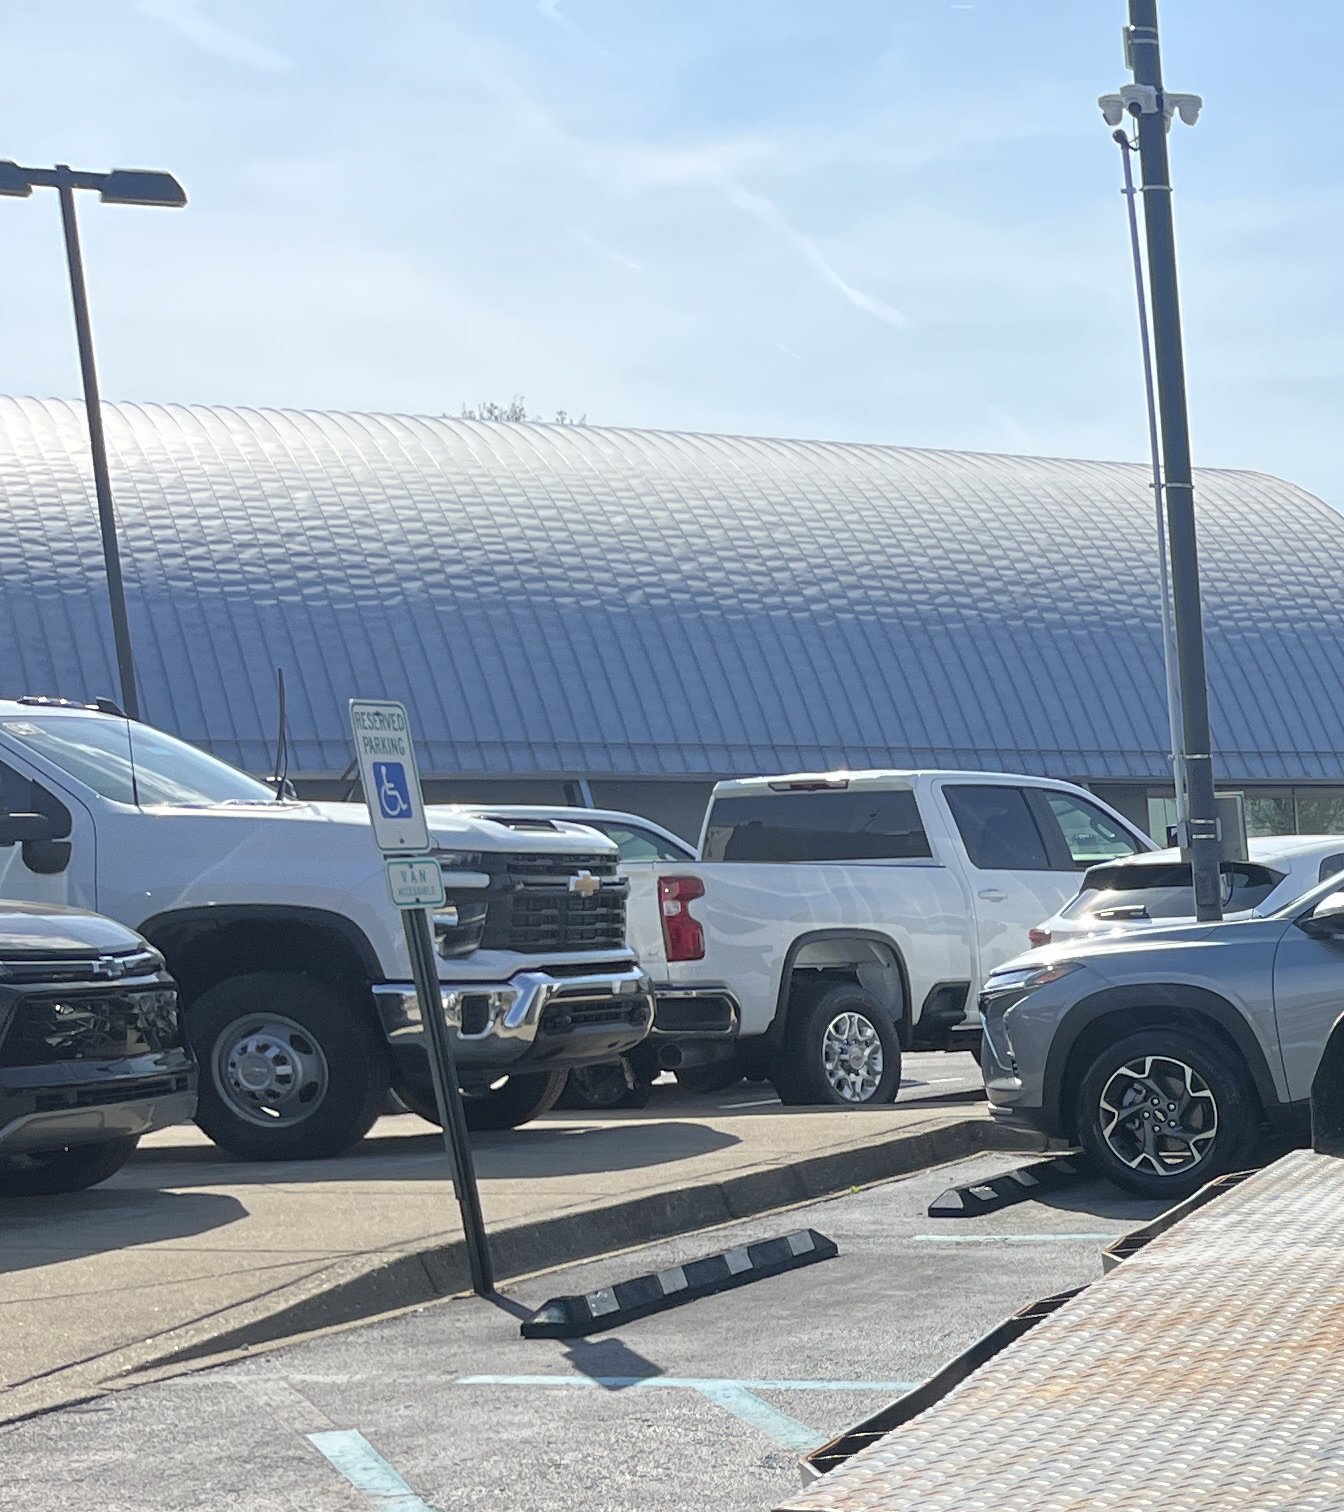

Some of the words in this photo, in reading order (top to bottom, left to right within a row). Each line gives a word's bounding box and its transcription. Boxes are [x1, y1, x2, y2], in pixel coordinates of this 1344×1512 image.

[354, 711, 404, 731] RESERVED
[362, 735, 406, 756] PARKING
[400, 870, 427, 883] VAN
